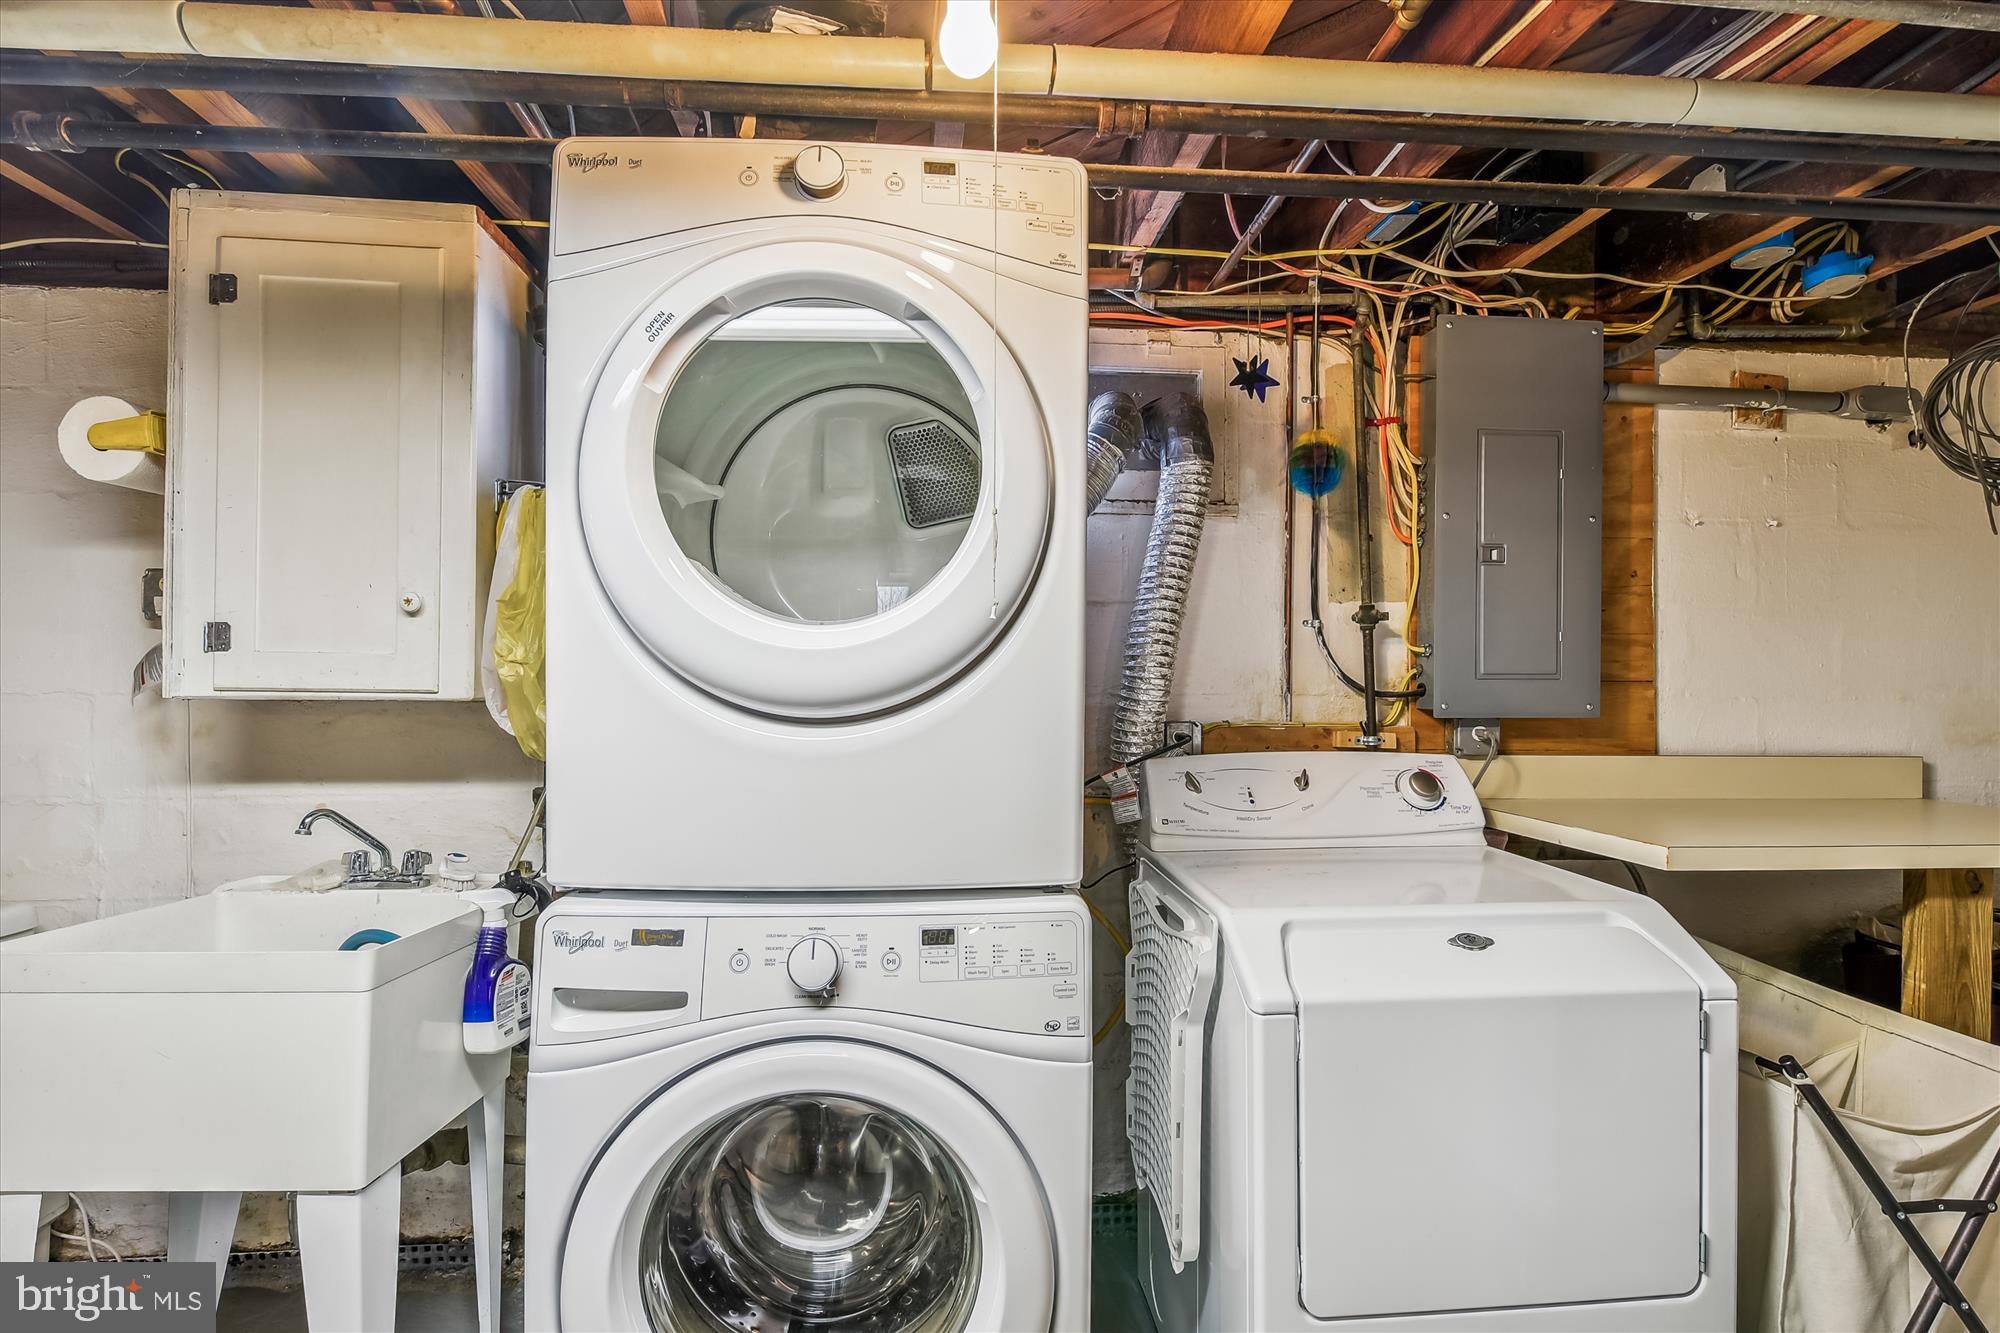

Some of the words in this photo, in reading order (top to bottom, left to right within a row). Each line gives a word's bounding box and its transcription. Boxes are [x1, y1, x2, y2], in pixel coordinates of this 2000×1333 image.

[567, 155, 618, 170] Whirlpool
[628, 158, 642, 167] Duet
[645, 310, 665, 333] OPEN
[648, 312, 676, 342] OUVRIR
[1183, 802, 1210, 815] Temperature
[553, 935, 605, 951] Whirlpool
[613, 939, 629, 948] Duet
